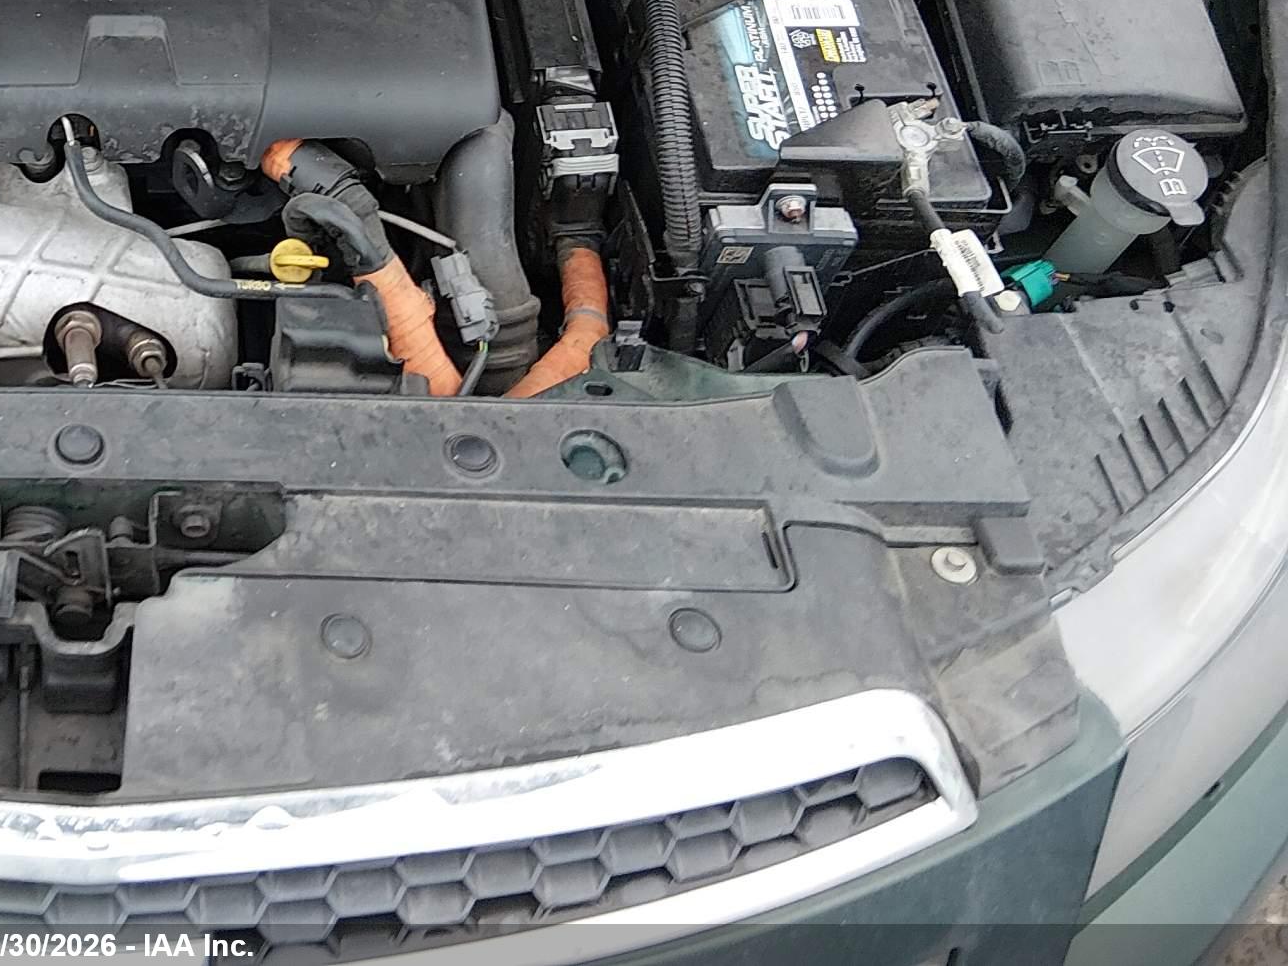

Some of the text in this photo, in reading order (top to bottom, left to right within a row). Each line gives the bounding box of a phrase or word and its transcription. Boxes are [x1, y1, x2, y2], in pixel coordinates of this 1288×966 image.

[741, 4, 767, 63] PLATINUM
[734, 64, 765, 141] SUPER
[758, 67, 792, 151] START
[235, 279, 272, 292] TURBO
